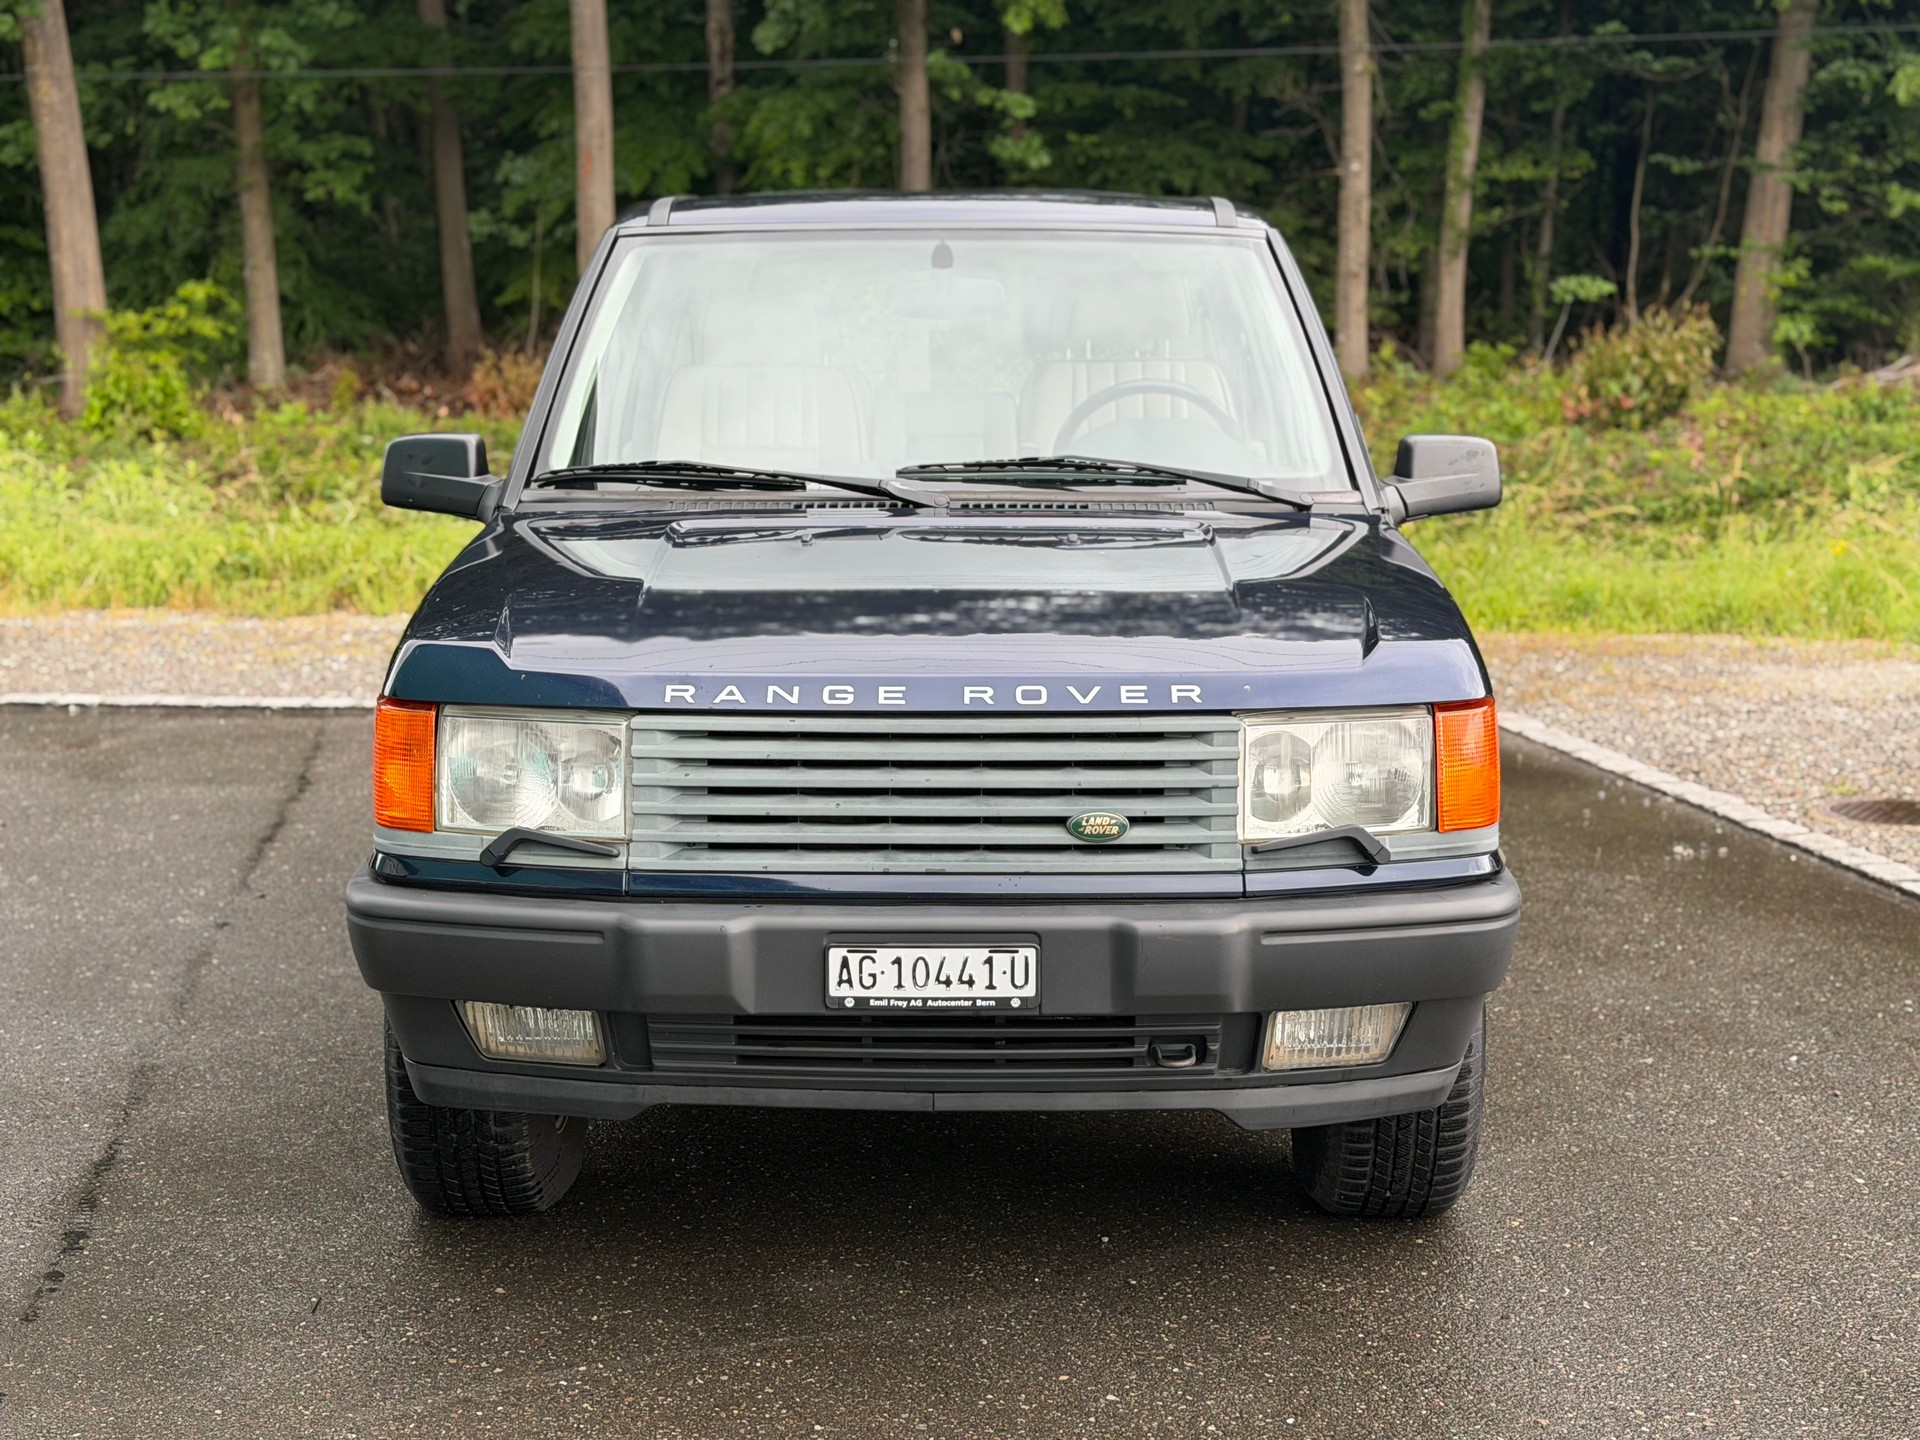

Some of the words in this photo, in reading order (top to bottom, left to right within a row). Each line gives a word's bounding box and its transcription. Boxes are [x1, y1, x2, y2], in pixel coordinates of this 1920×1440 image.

[663, 684, 907, 706] RANGE
[963, 684, 1203, 705] ROVER
[1081, 816, 1111, 826] LAND
[1083, 825, 1120, 835] ROVER
[869, 998, 888, 1007] Emil
[889, 999, 908, 1009] Frey
[909, 999, 923, 1007] AG
[926, 999, 973, 1007] Autocenter
[975, 998, 996, 1007] Bern
